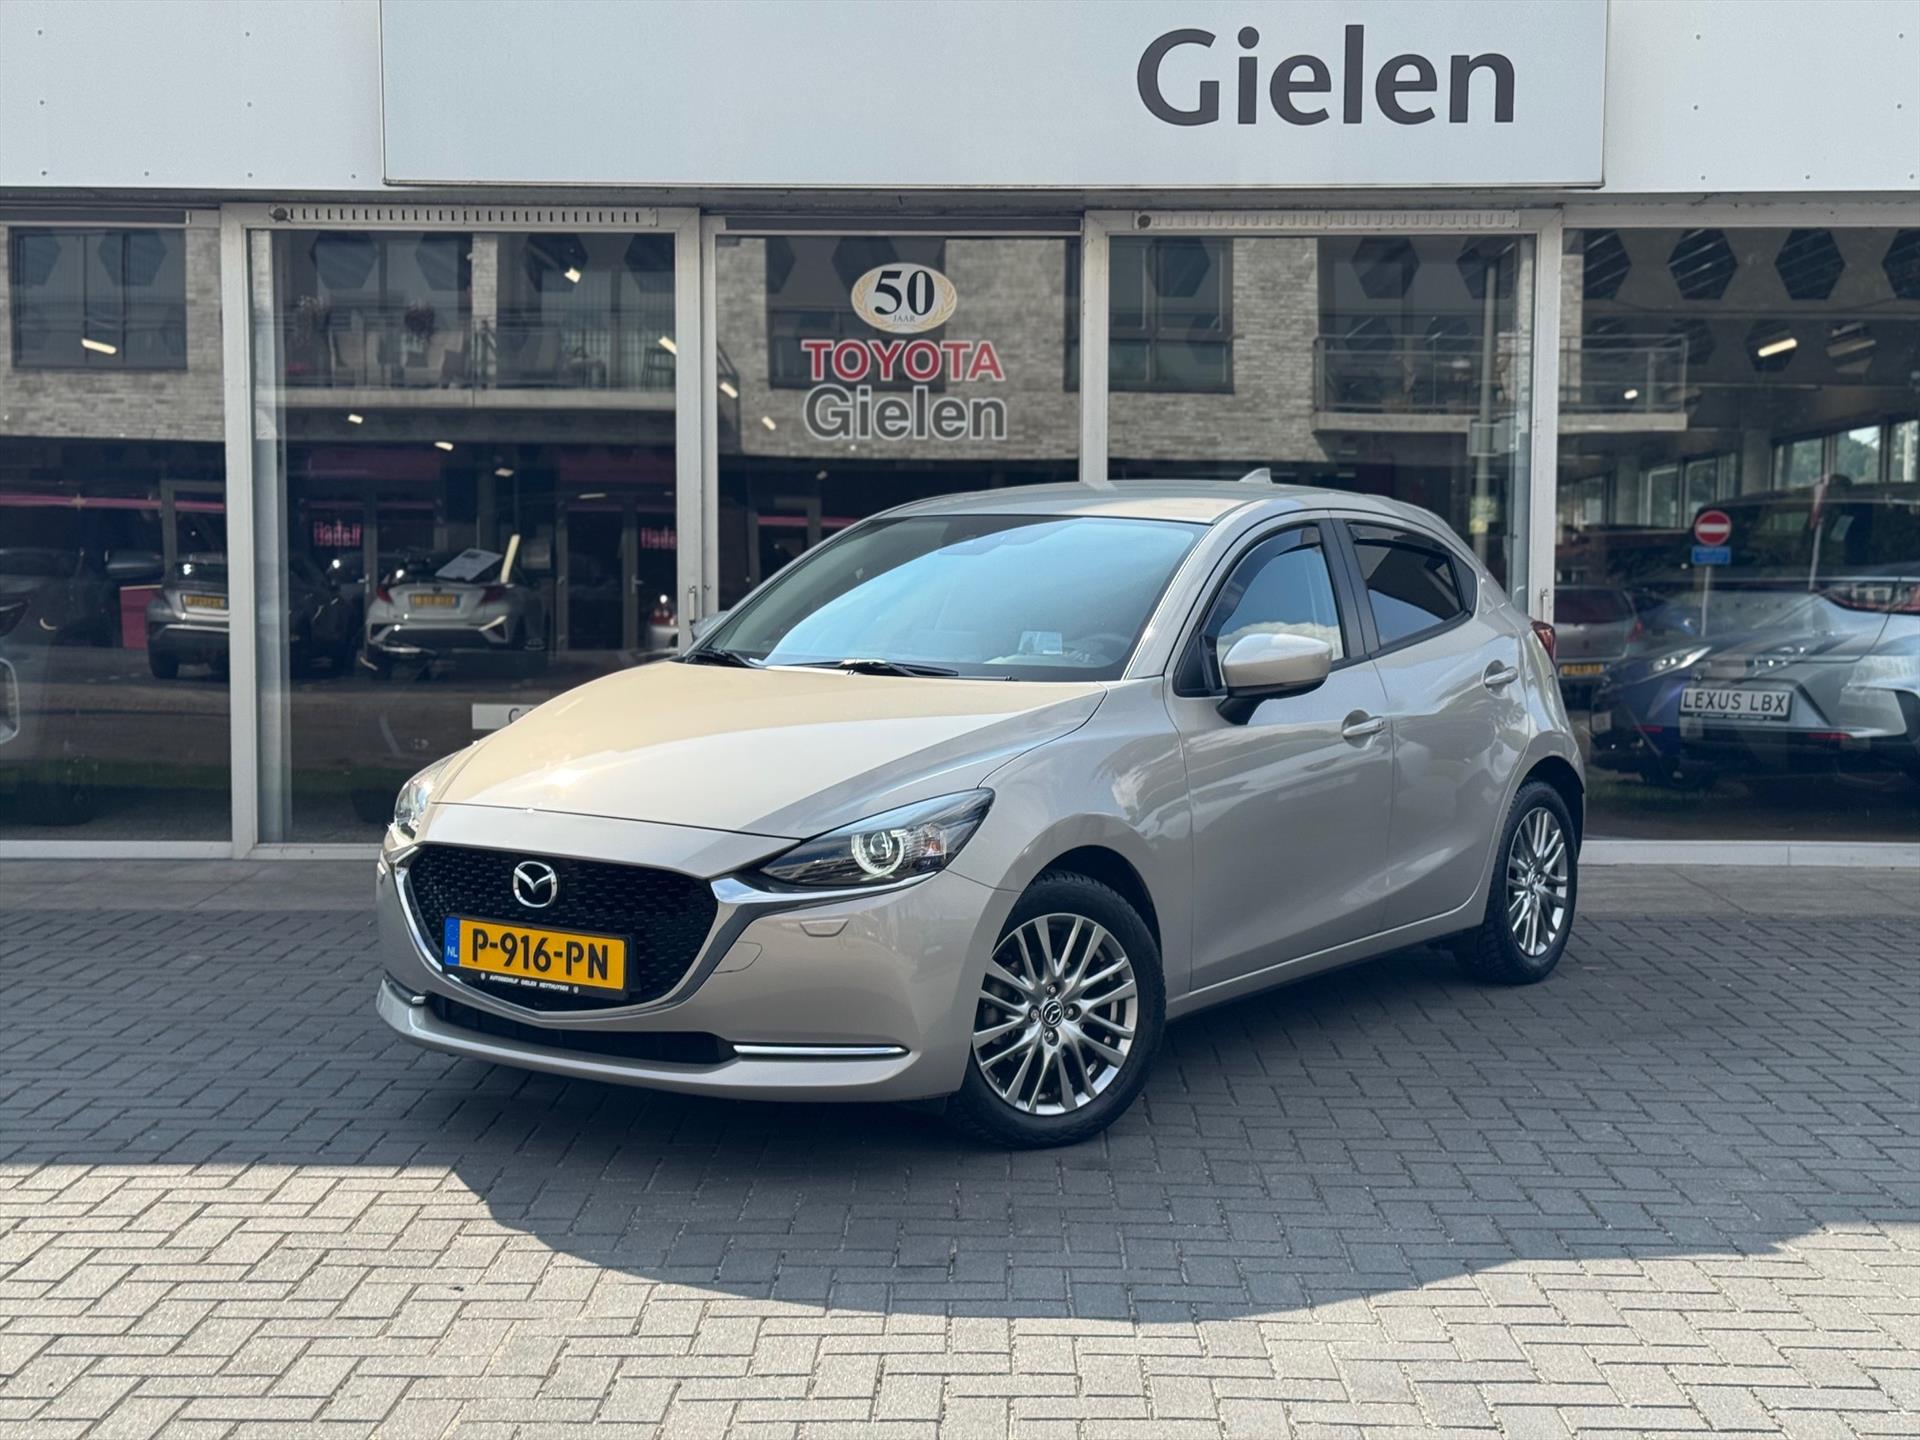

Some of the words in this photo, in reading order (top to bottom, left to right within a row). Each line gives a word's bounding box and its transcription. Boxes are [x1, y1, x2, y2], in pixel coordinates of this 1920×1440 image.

[1137, 24, 1515, 126] Gielen
[873, 269, 936, 316] 50
[893, 314, 916, 323] JAAR
[802, 340, 1005, 381] TOYOTA
[803, 384, 1007, 440] Gielen
[1683, 690, 1742, 710] LEXUS
[1749, 693, 1786, 713] LBX
[472, 927, 608, 981] P-916-PN
